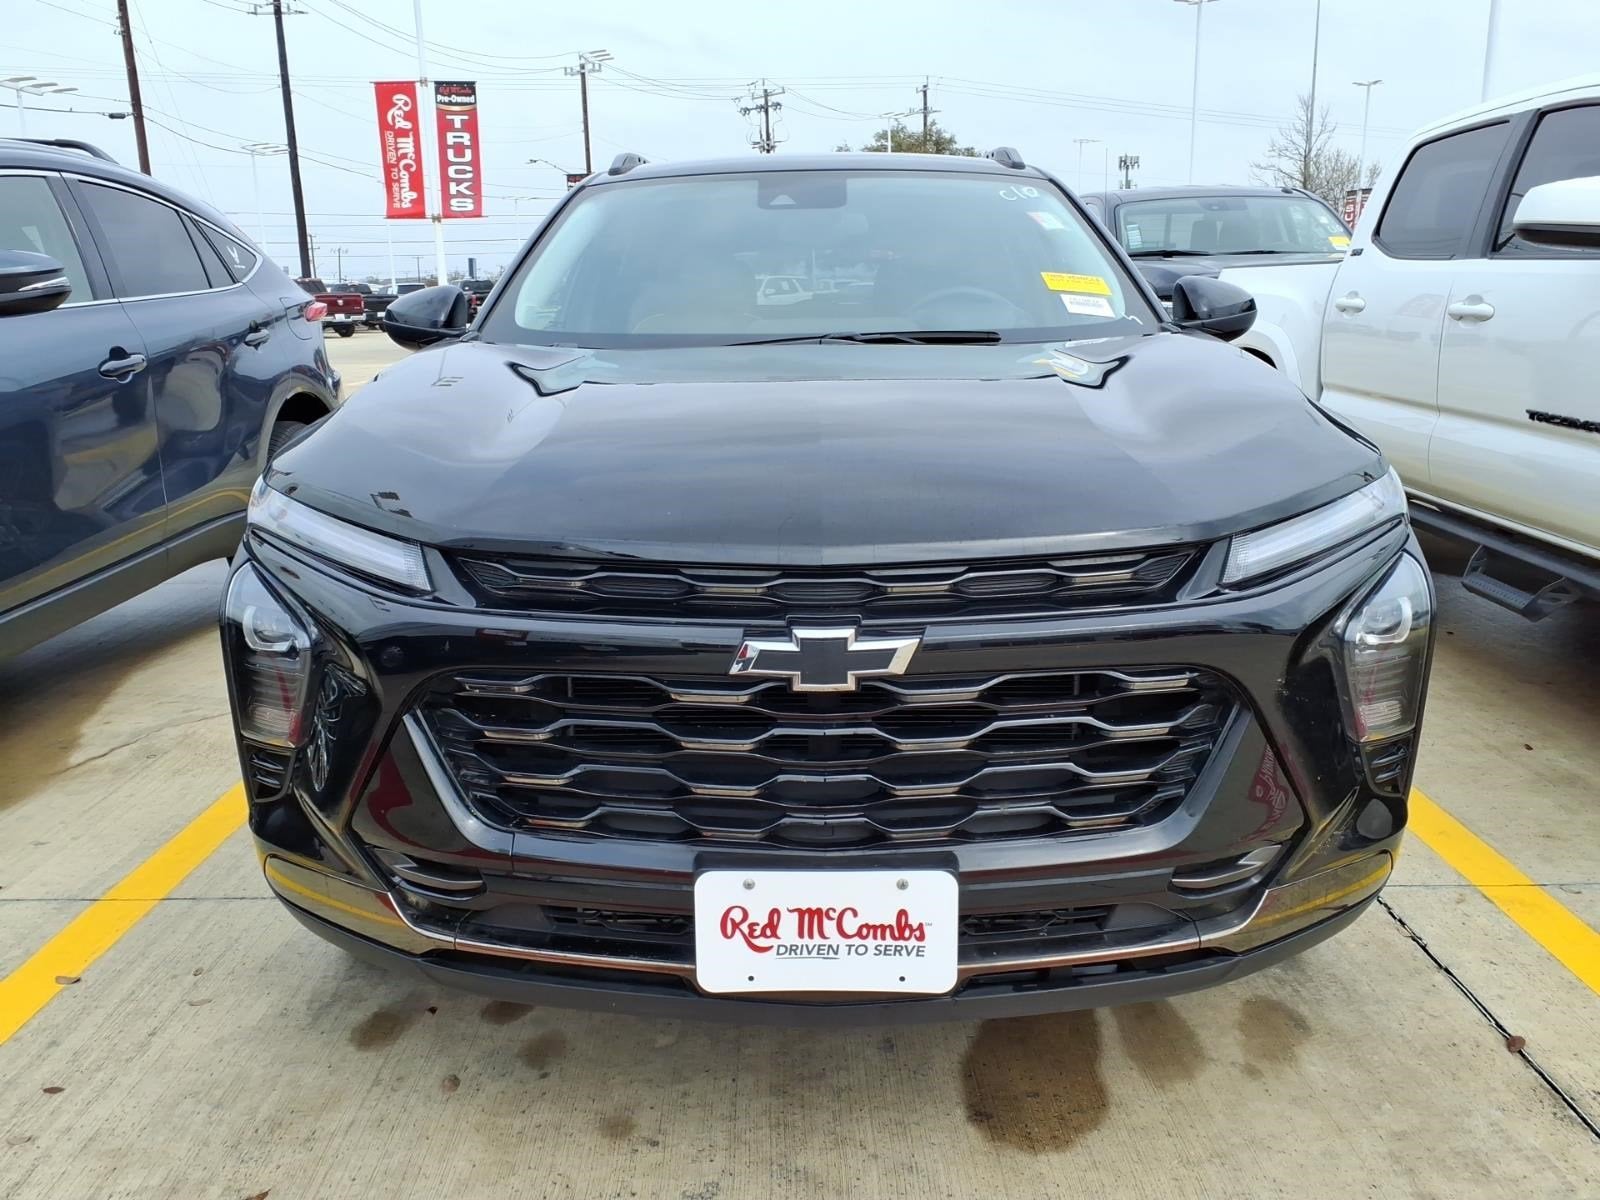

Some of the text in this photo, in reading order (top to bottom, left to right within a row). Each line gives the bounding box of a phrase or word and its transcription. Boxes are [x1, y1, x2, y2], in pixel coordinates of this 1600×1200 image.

[437, 94, 475, 103] Pre-Owned
[386, 131, 400, 208] DRIVEN TO SERVE
[387, 94, 418, 209] Red McCombs
[446, 115, 475, 211] TRUCKS
[719, 905, 782, 953] Red
[787, 907, 926, 942] McCombs
[776, 944, 926, 957] DRIVEN TO SERVE
